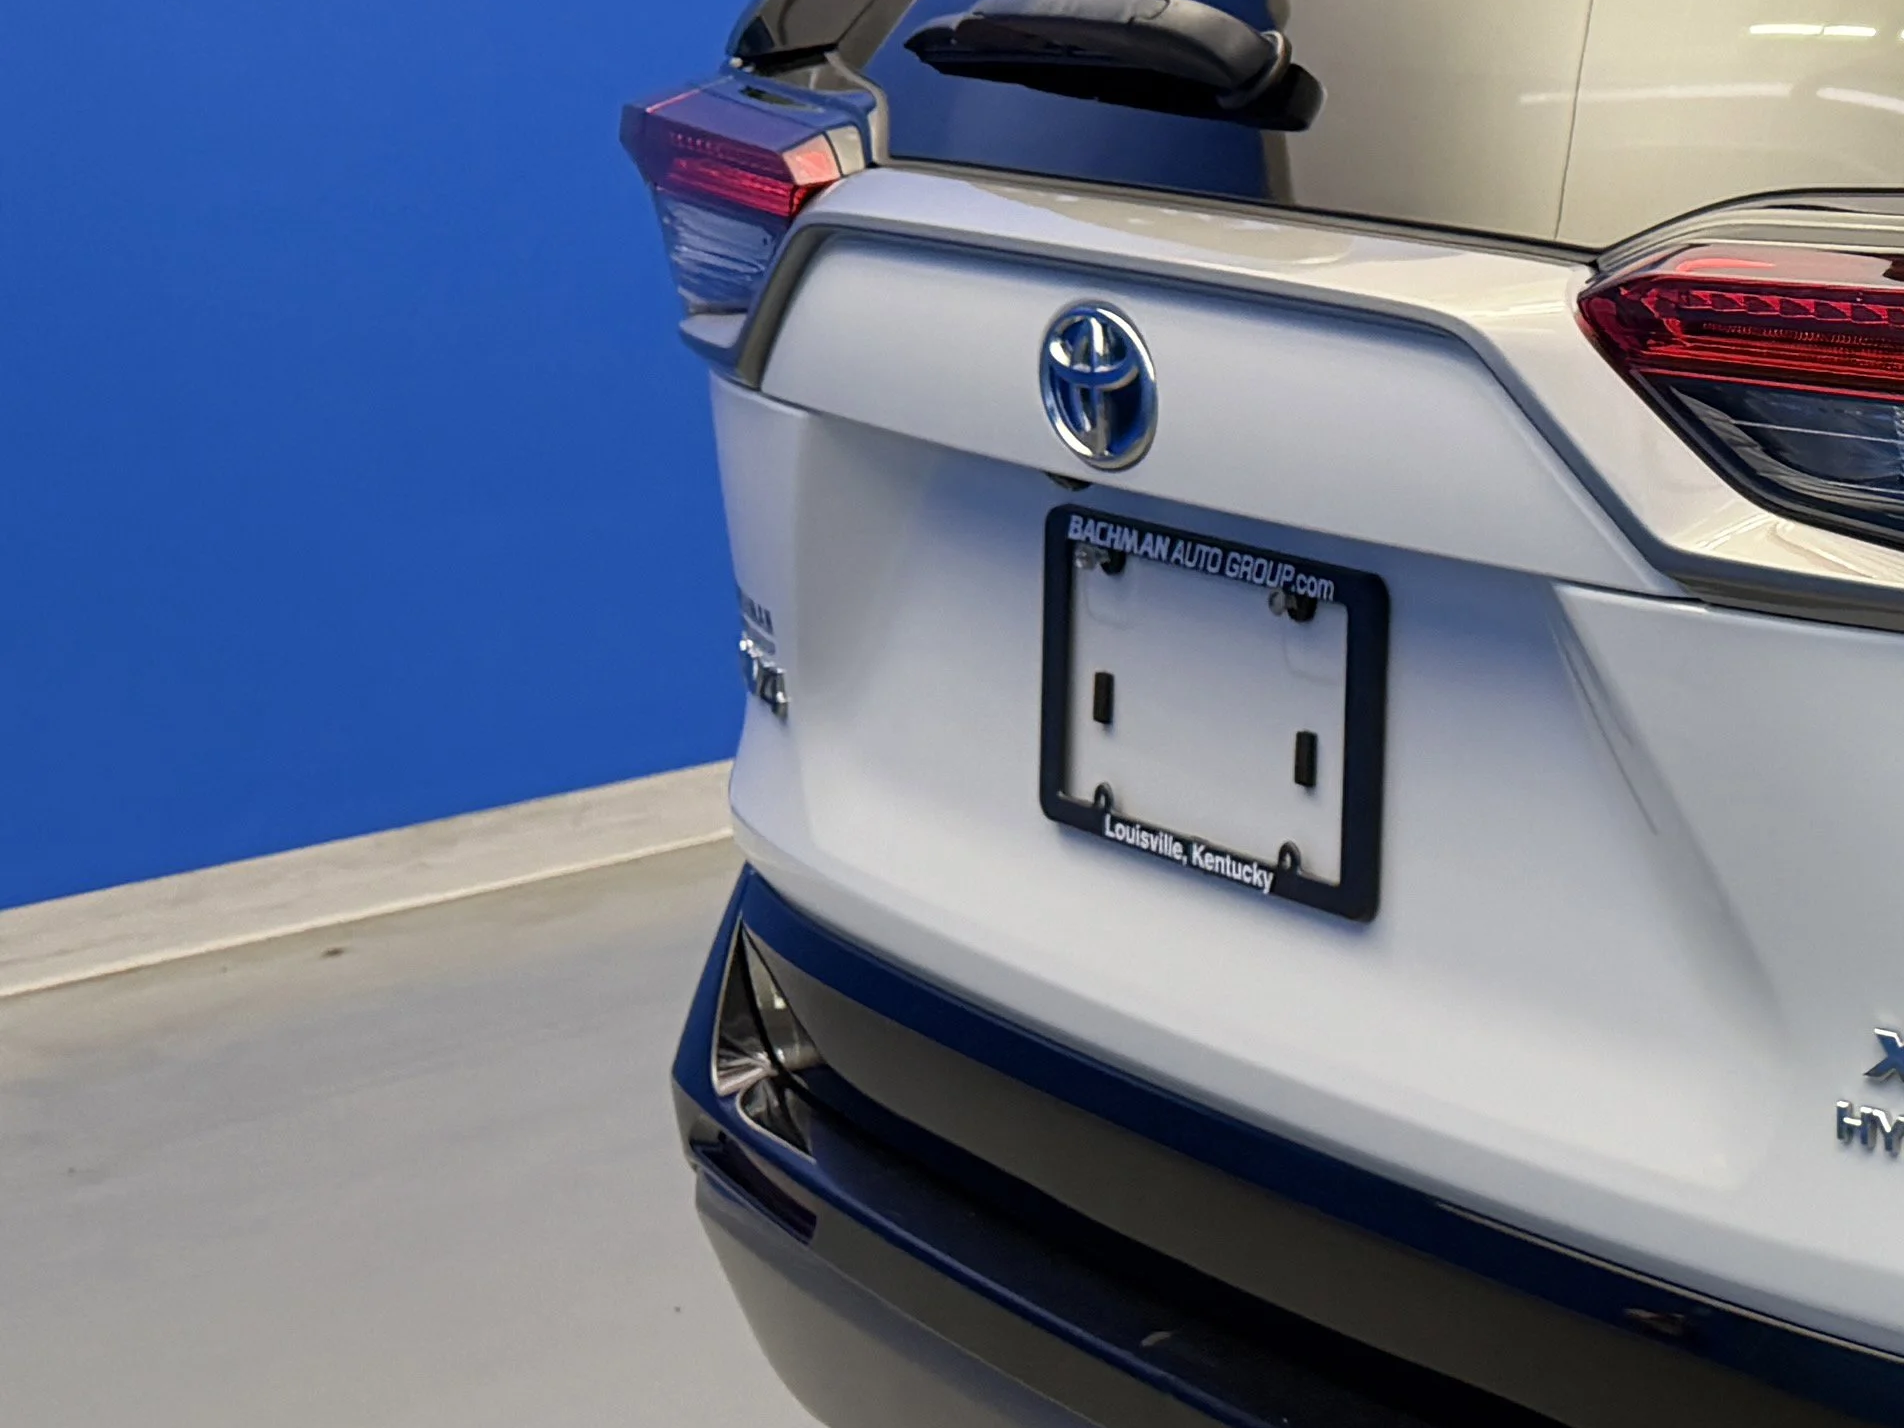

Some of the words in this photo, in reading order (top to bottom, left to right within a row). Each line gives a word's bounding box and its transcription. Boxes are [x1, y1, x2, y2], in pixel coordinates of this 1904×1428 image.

[1068, 515, 1168, 561] BACHMAN
[1171, 539, 1221, 573] AUTO
[1224, 552, 1335, 601] GROUP.com
[1104, 814, 1187, 865] Louisville,
[1192, 842, 1273, 894] Kentucky
